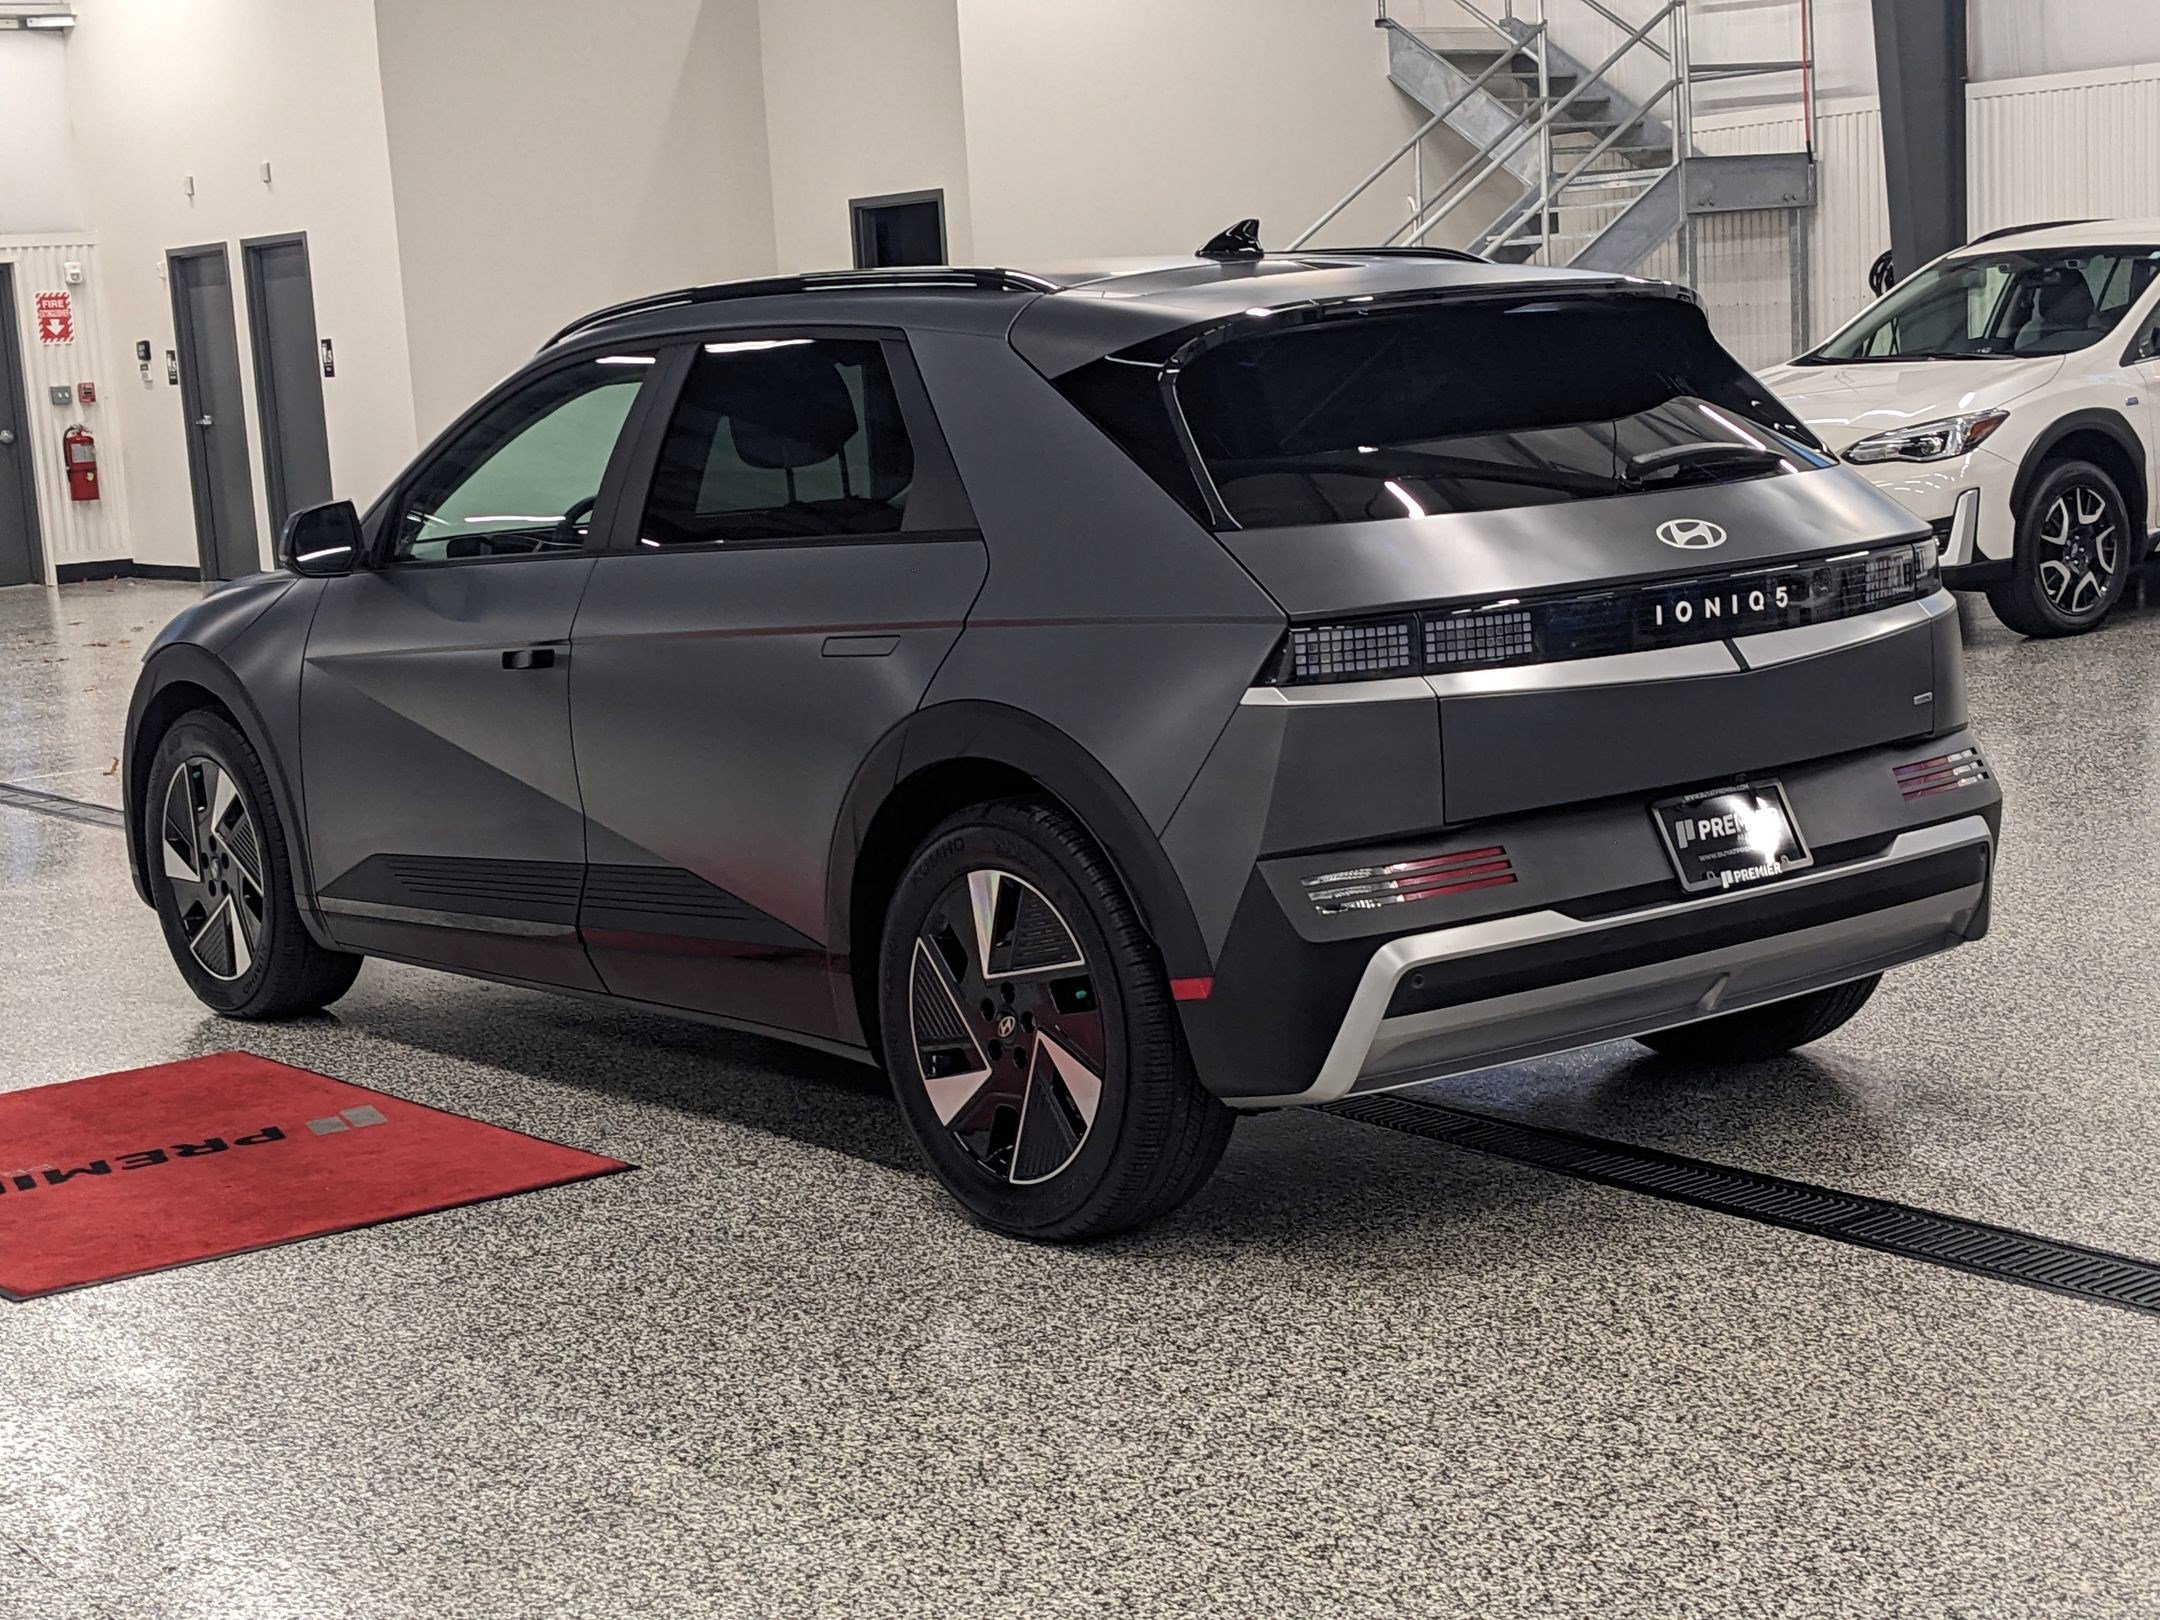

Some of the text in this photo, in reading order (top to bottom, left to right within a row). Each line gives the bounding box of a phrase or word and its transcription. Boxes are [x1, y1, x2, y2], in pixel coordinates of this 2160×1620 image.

[42, 299, 64, 309] FIRE
[1698, 809, 1752, 840] PREM
[1733, 862, 1782, 884] PREMIER
[0, 1126, 286, 1195] PREMI
